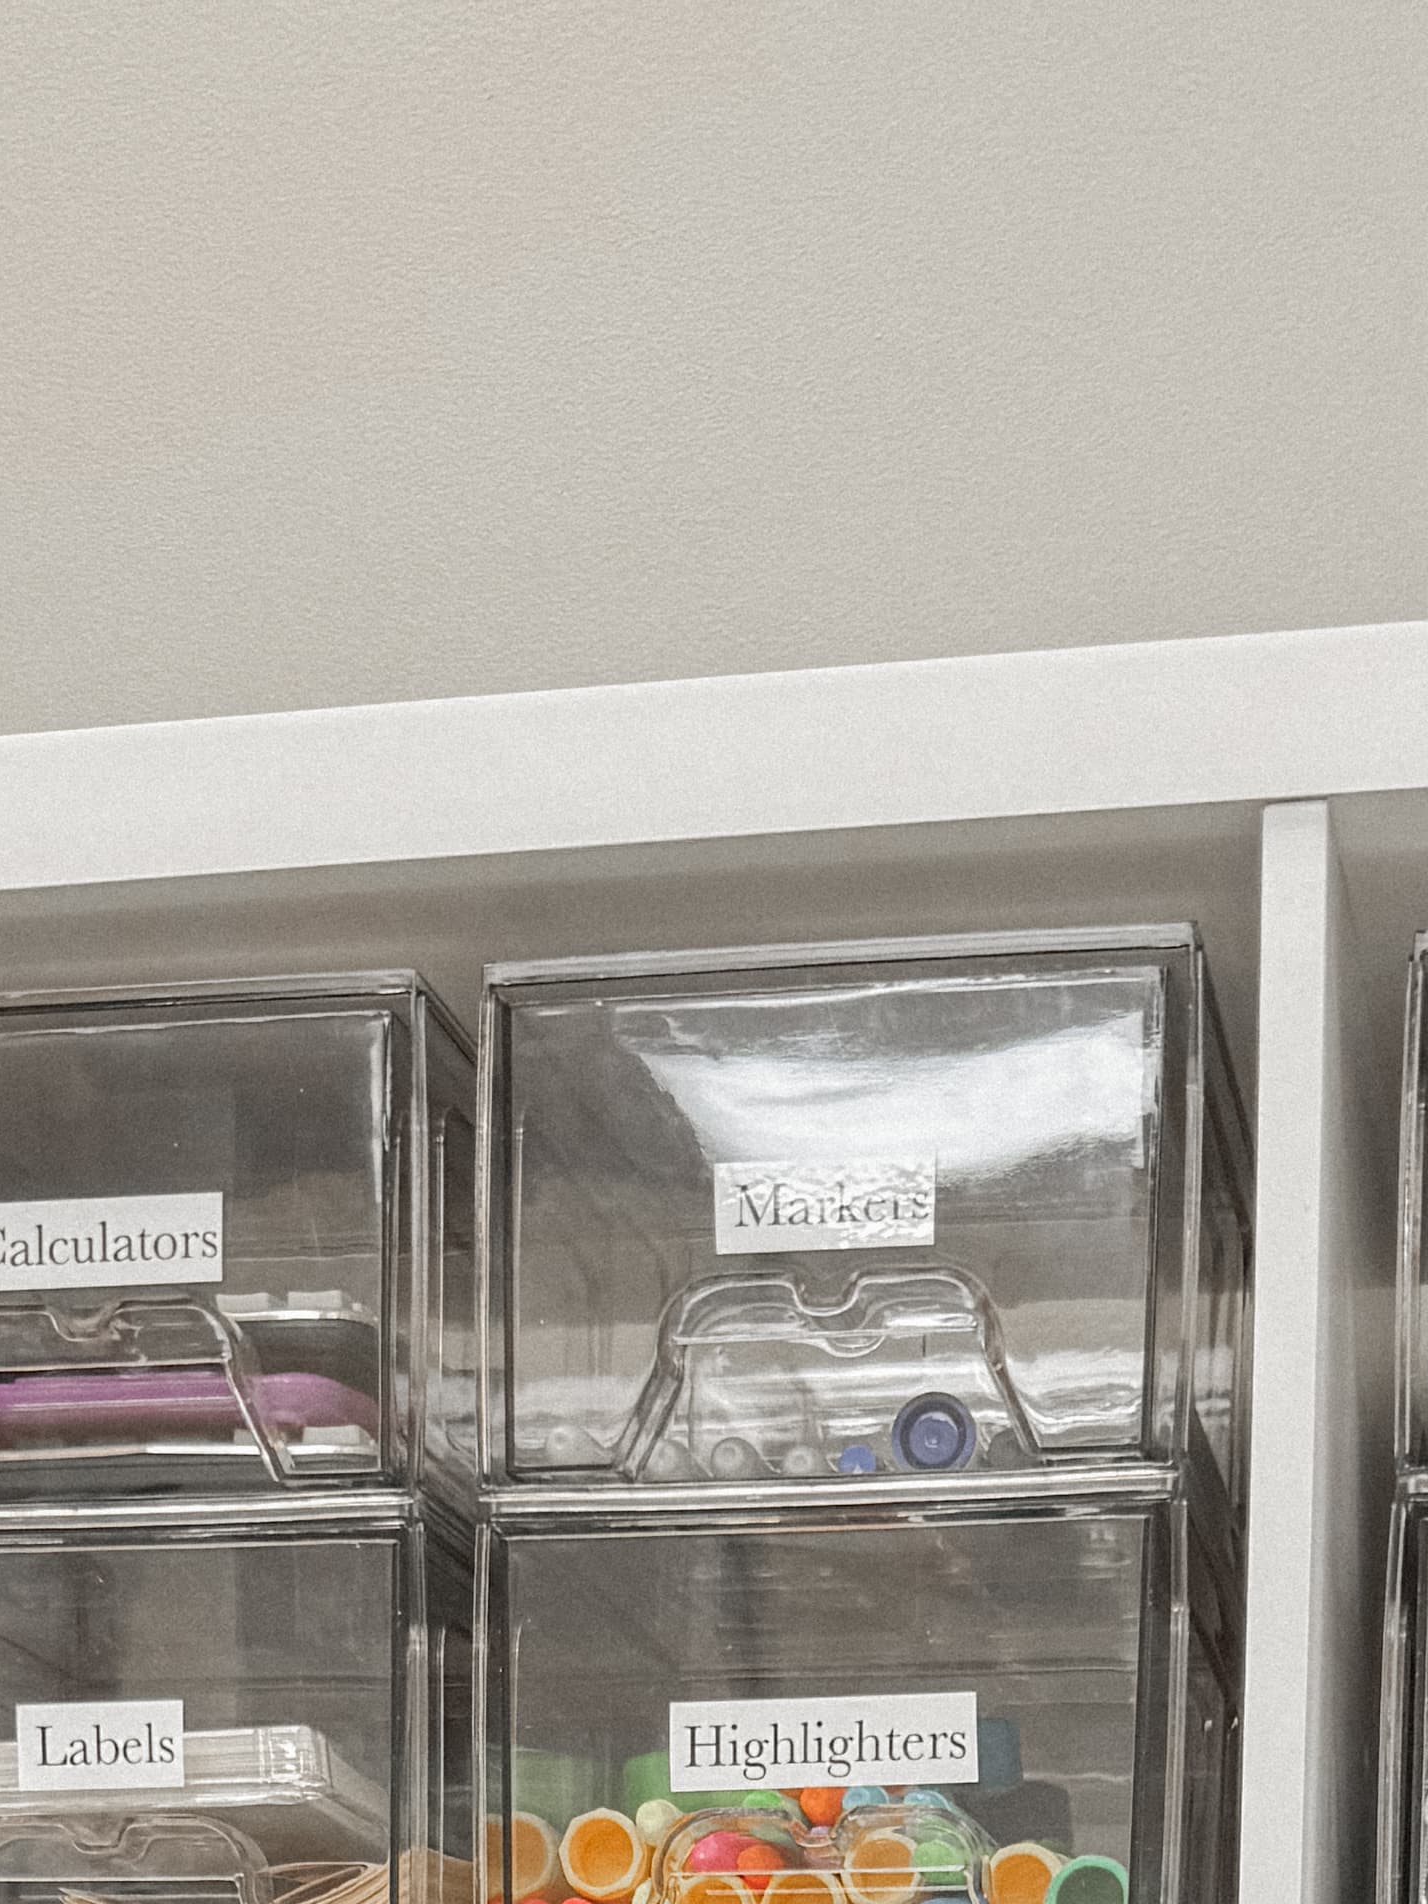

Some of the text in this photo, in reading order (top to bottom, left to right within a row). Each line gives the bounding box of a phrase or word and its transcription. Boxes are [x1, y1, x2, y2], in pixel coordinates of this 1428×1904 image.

[733, 1183, 930, 1230] Markers
[35, 1722, 176, 1768] Labels
[683, 1719, 968, 1781] Highlighters
